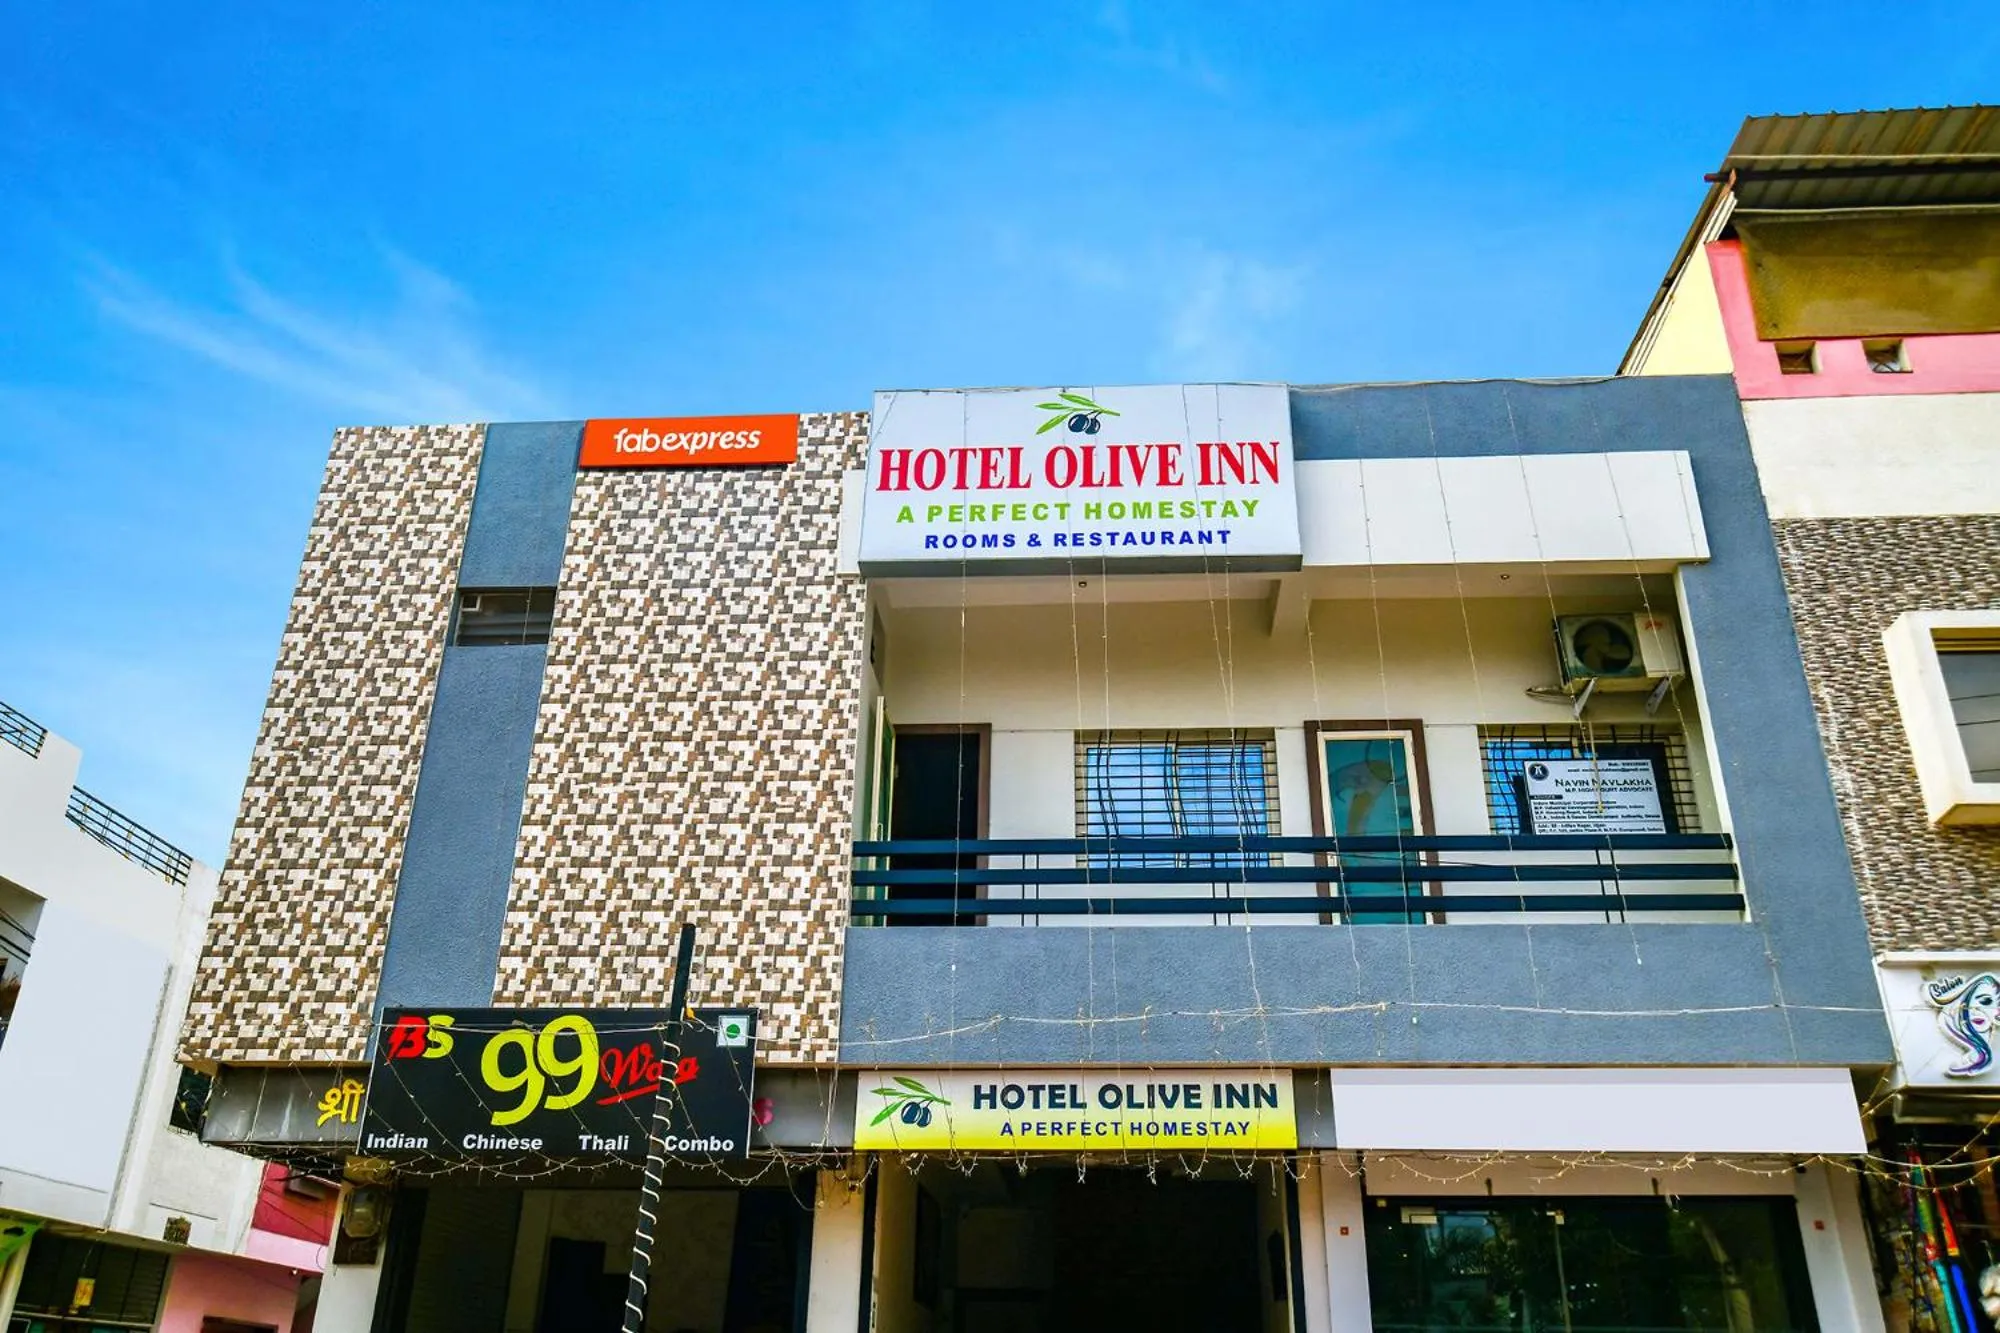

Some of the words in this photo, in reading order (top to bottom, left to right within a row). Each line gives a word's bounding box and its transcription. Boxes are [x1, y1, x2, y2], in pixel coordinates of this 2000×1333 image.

[612, 427, 762, 455] fabexpress
[876, 447, 1031, 492] HOTEL
[1045, 444, 1184, 490] OLIVE
[1197, 441, 1280, 486] INN
[896, 505, 915, 523] A
[927, 502, 1070, 523] PERFECT
[1084, 499, 1260, 521] HOMESTAY
[925, 533, 1016, 549] ROOMS
[1026, 533, 1043, 548] &
[1054, 530, 1231, 548] RESTAURANT
[1555, 779, 1589, 788] NAVIN
[1592, 778, 1652, 787] NAVLAKHA
[1931, 977, 1963, 997] Salon
[481, 1015, 599, 1126] 99
[316, 1078, 365, 1128] श्री
[973, 1084, 1087, 1110] HOTEL
[1098, 1084, 1202, 1109] OLIVE
[1213, 1083, 1279, 1109] INN
[1000, 1122, 1014, 1136] A
[1021, 1122, 1121, 1136] PERFECT
[1130, 1121, 1251, 1136] HOMESTAY
[366, 1132, 429, 1150] Indian
[462, 1134, 543, 1151] Chinese
[579, 1135, 629, 1151] Thali
[664, 1135, 734, 1152] Combo
